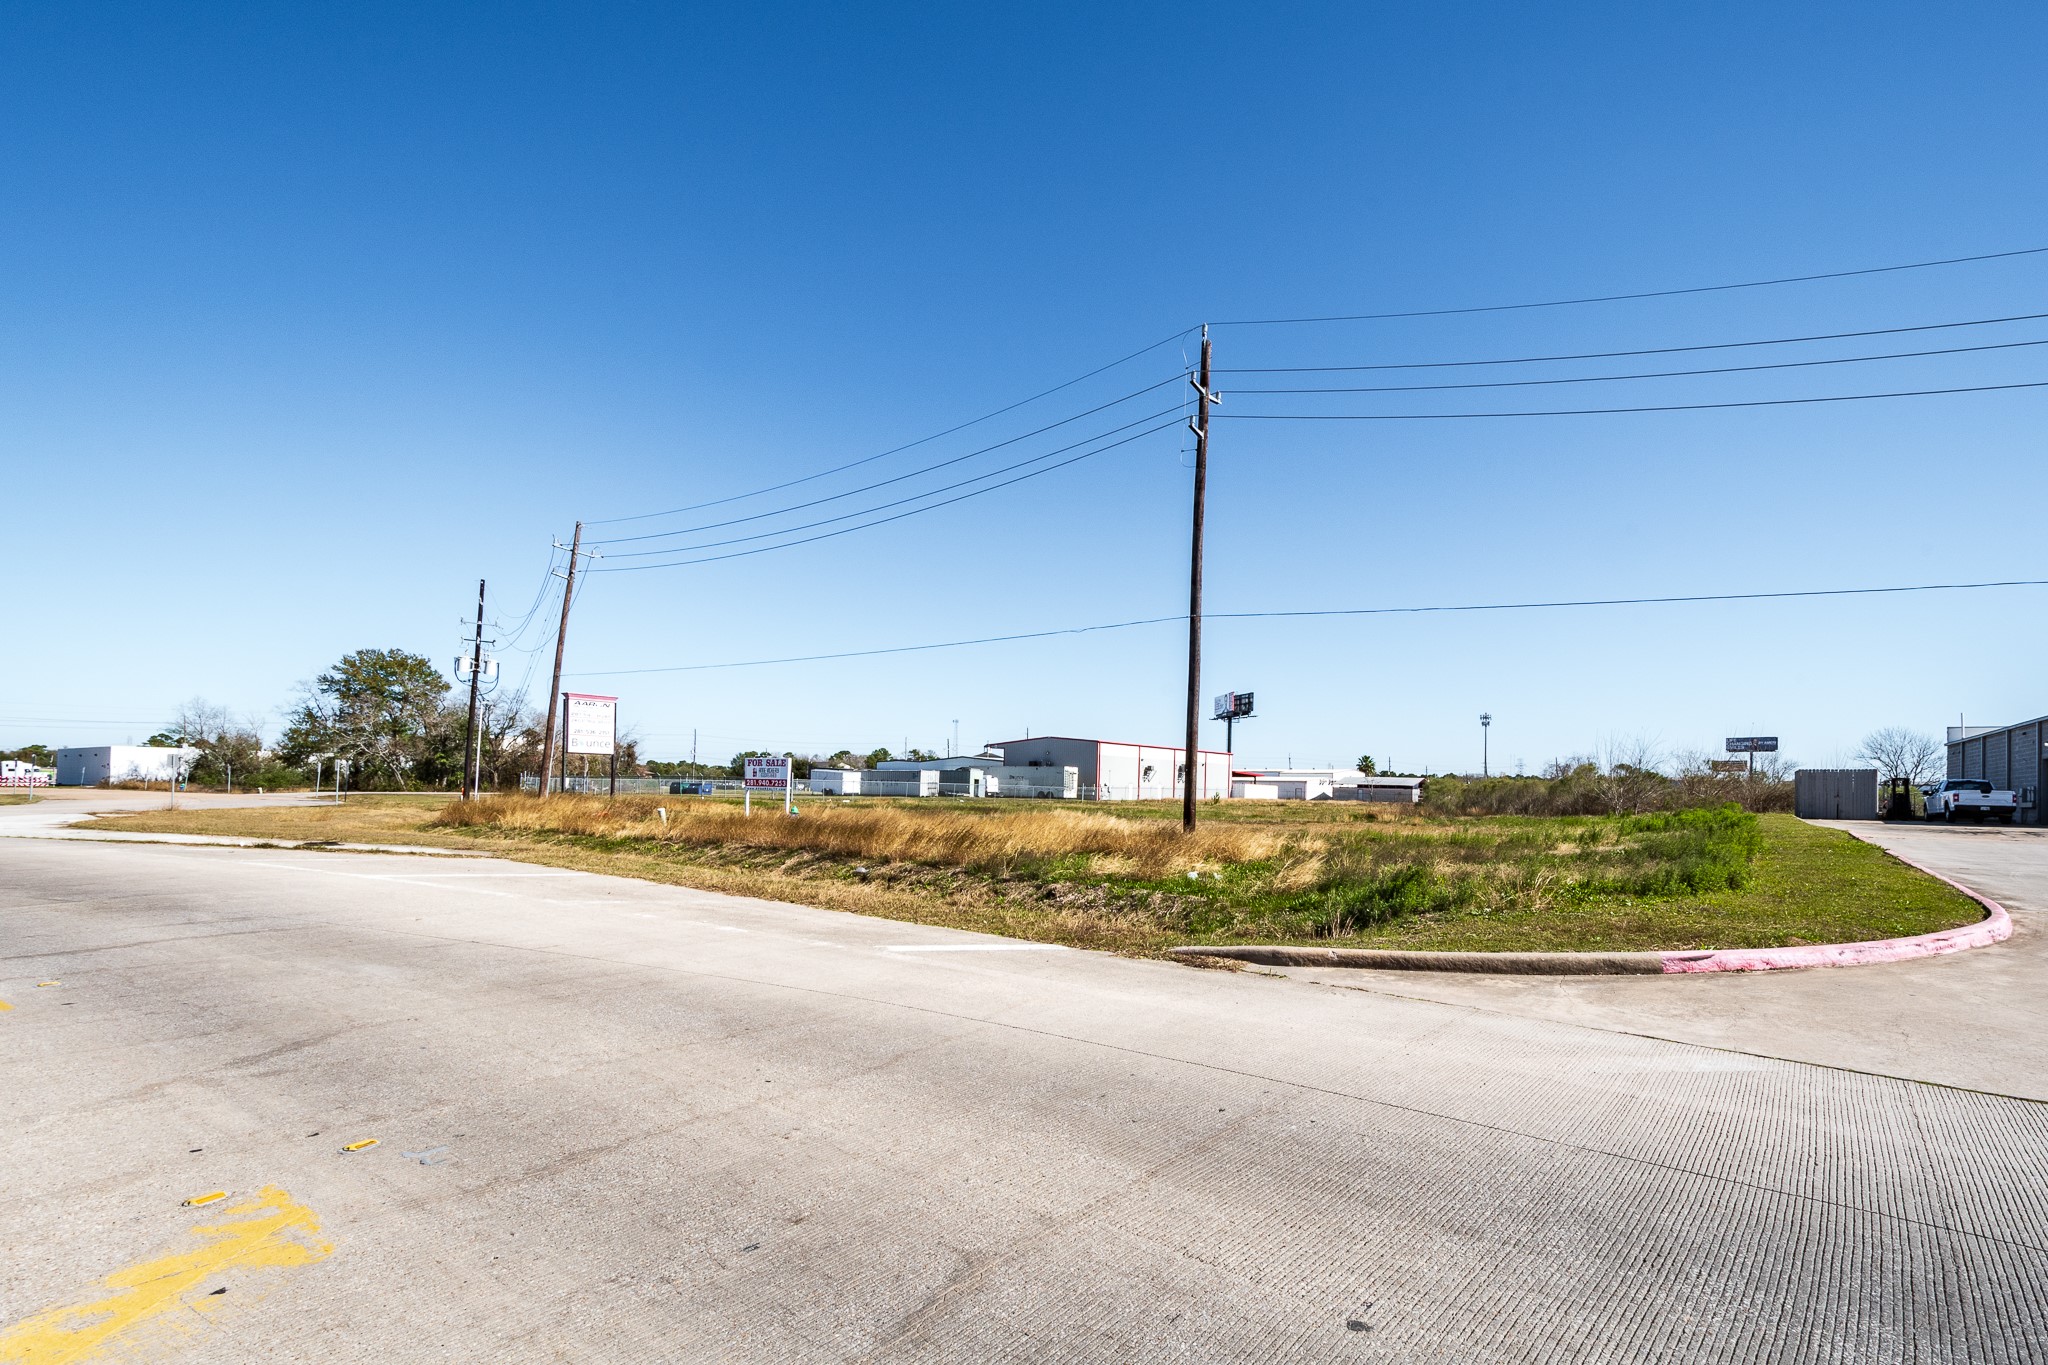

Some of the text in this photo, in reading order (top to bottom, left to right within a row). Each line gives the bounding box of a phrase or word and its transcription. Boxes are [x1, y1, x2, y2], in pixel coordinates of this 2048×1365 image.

[747, 759, 787, 767] FOR SALE
[746, 779, 787, 787] 281.940.7253
